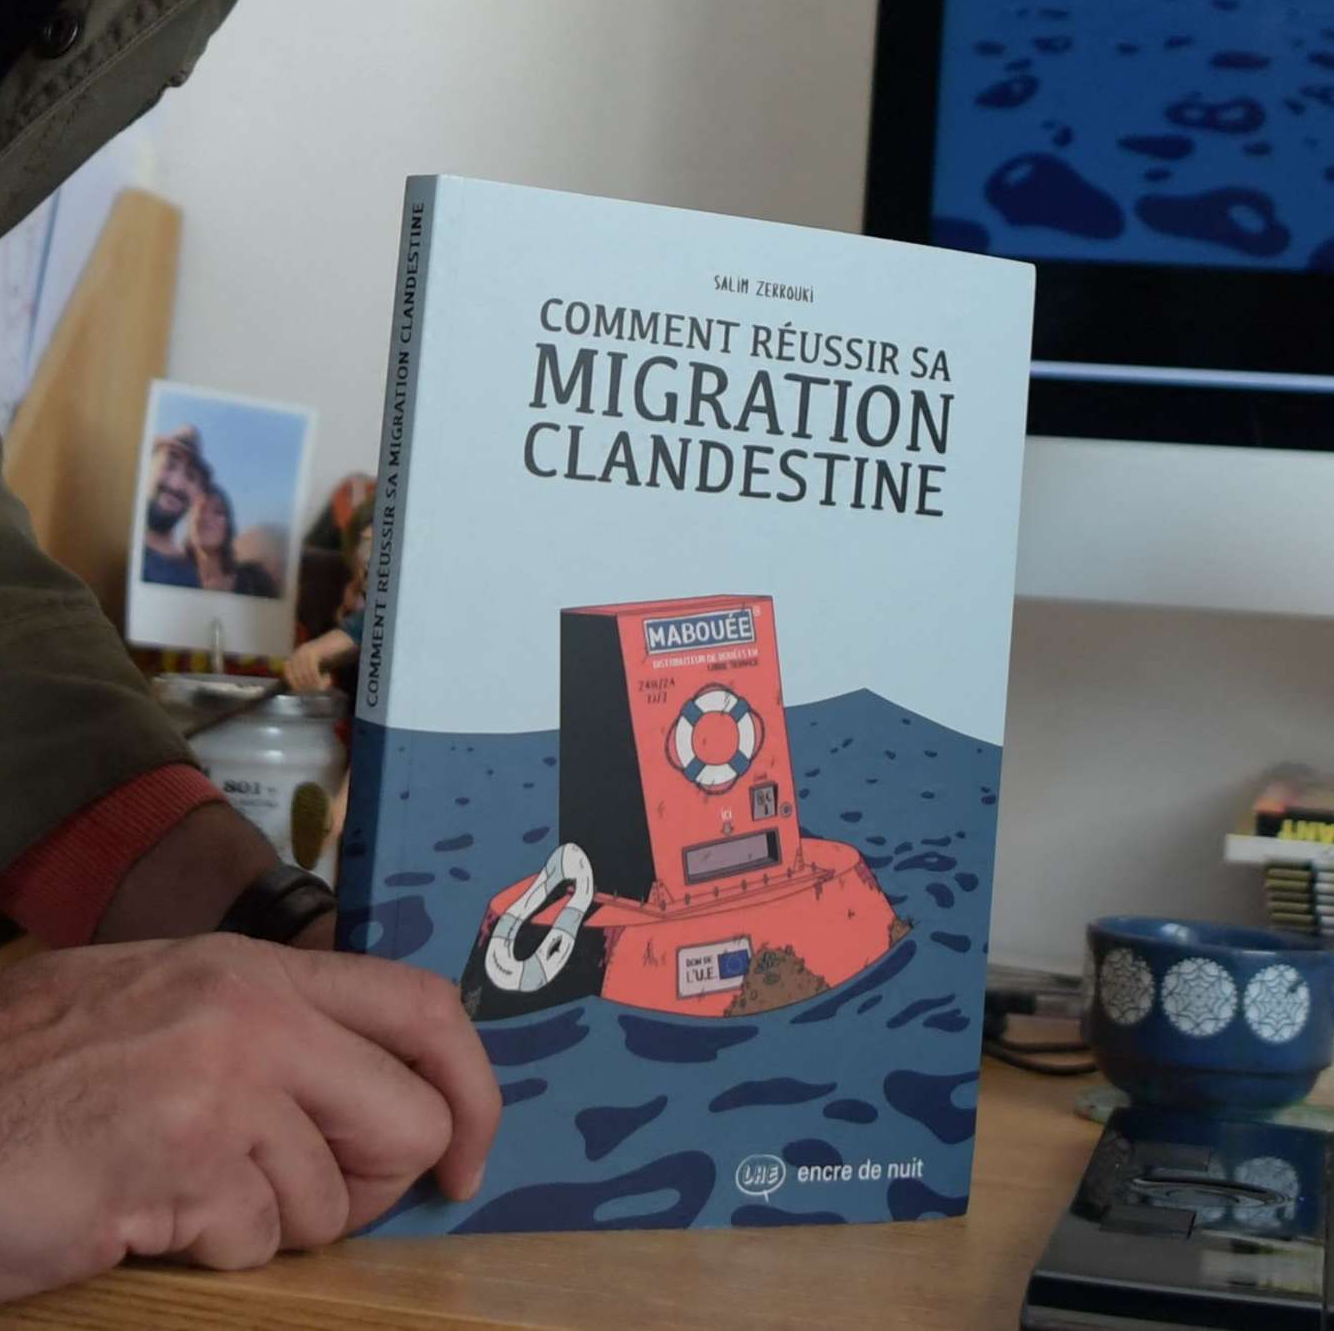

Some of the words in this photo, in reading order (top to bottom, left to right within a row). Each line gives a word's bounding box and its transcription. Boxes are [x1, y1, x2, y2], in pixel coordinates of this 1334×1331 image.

[399, 202, 425, 344] CLANDESTINE
[539, 297, 740, 354] COMMENT
[750, 321, 899, 375] RÉUSSIR
[910, 346, 951, 382] SA
[387, 350, 410, 467] MIGRATION
[528, 343, 955, 455] MIGRATION
[384, 472, 399, 499] SA
[523, 422, 946, 517] CLANDESTINE
[372, 505, 396, 593] RÉUSSIR
[365, 599, 388, 708] COMMENT
[648, 613, 752, 648] MABOUÉE
[797, 1164, 854, 1183] encre
[858, 1158, 882, 1181] de
[887, 1156, 924, 1179] nuit
